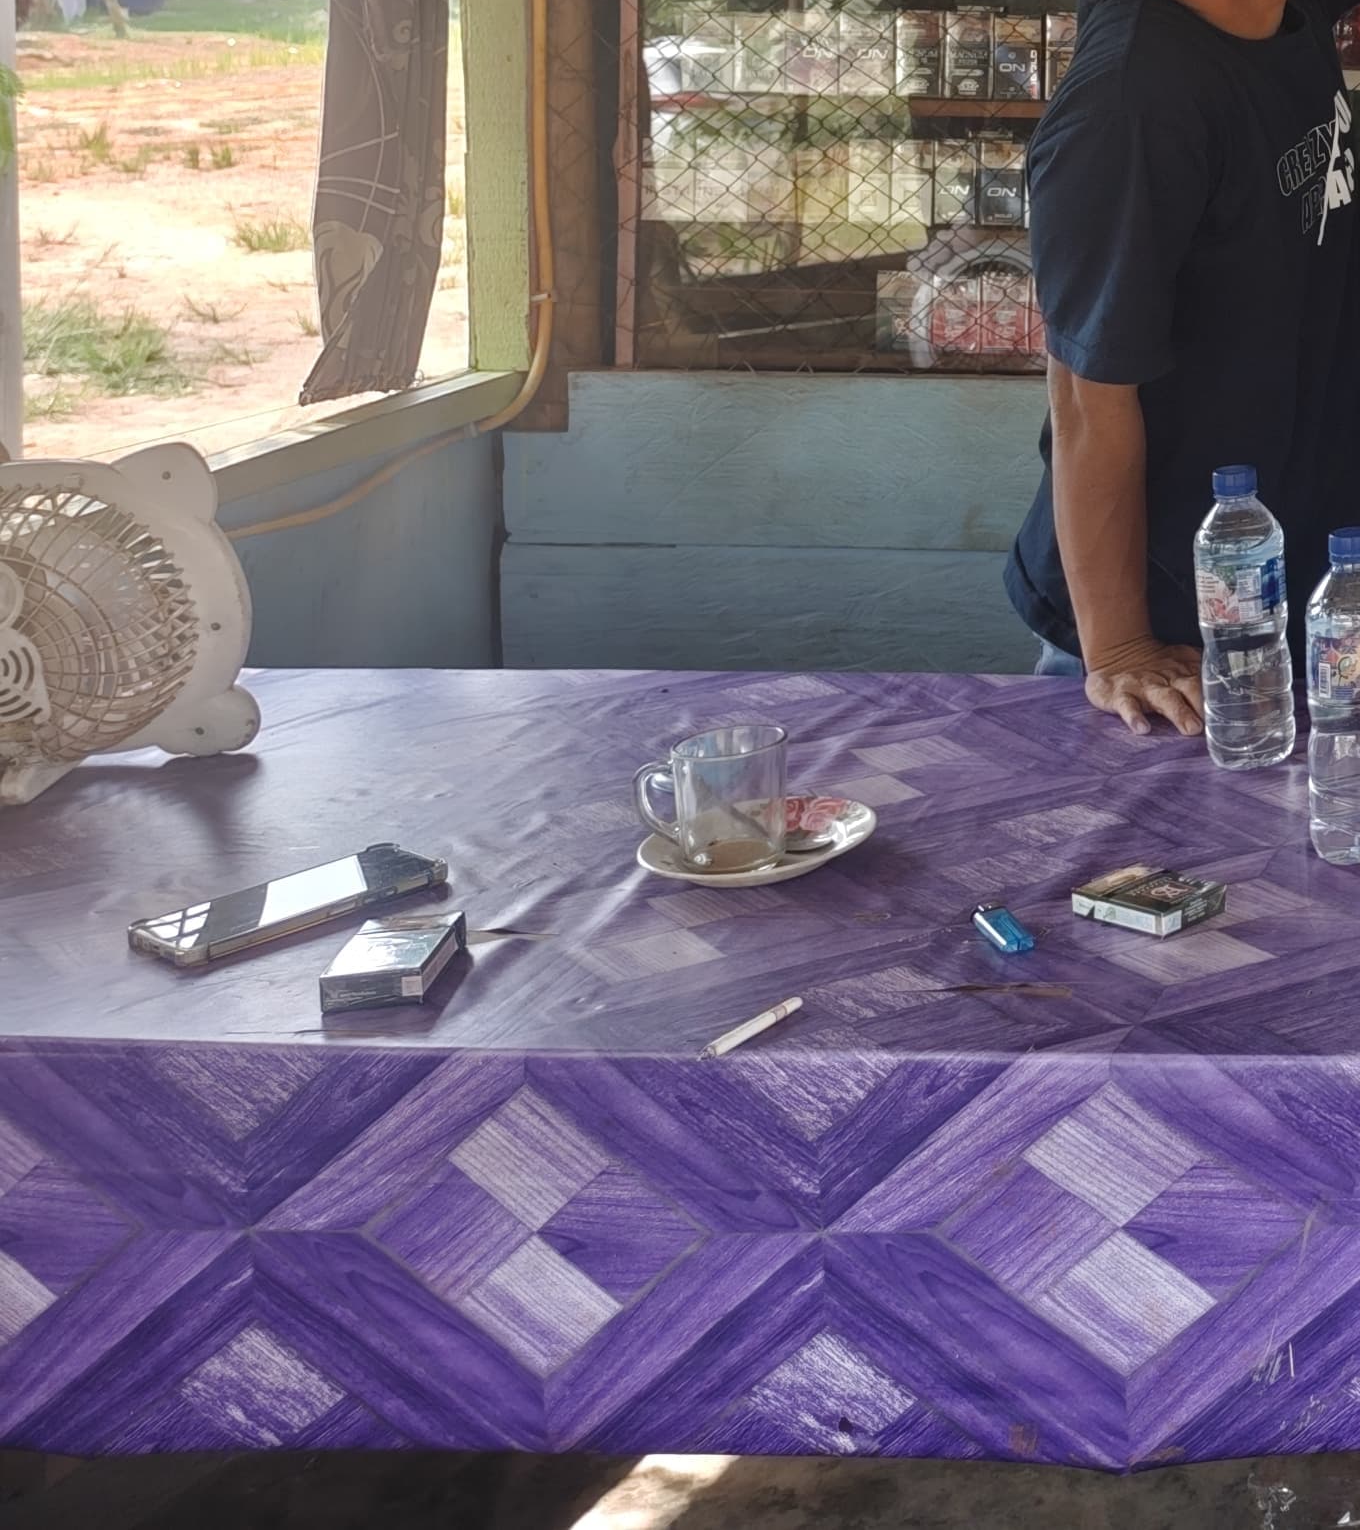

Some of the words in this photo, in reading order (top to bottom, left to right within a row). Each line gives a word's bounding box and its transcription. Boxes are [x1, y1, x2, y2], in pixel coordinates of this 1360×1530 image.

[857, 50, 888, 59] ON
[1000, 63, 1025, 72] ON
[939, 186, 969, 195] ON
[987, 188, 1017, 197] ON
